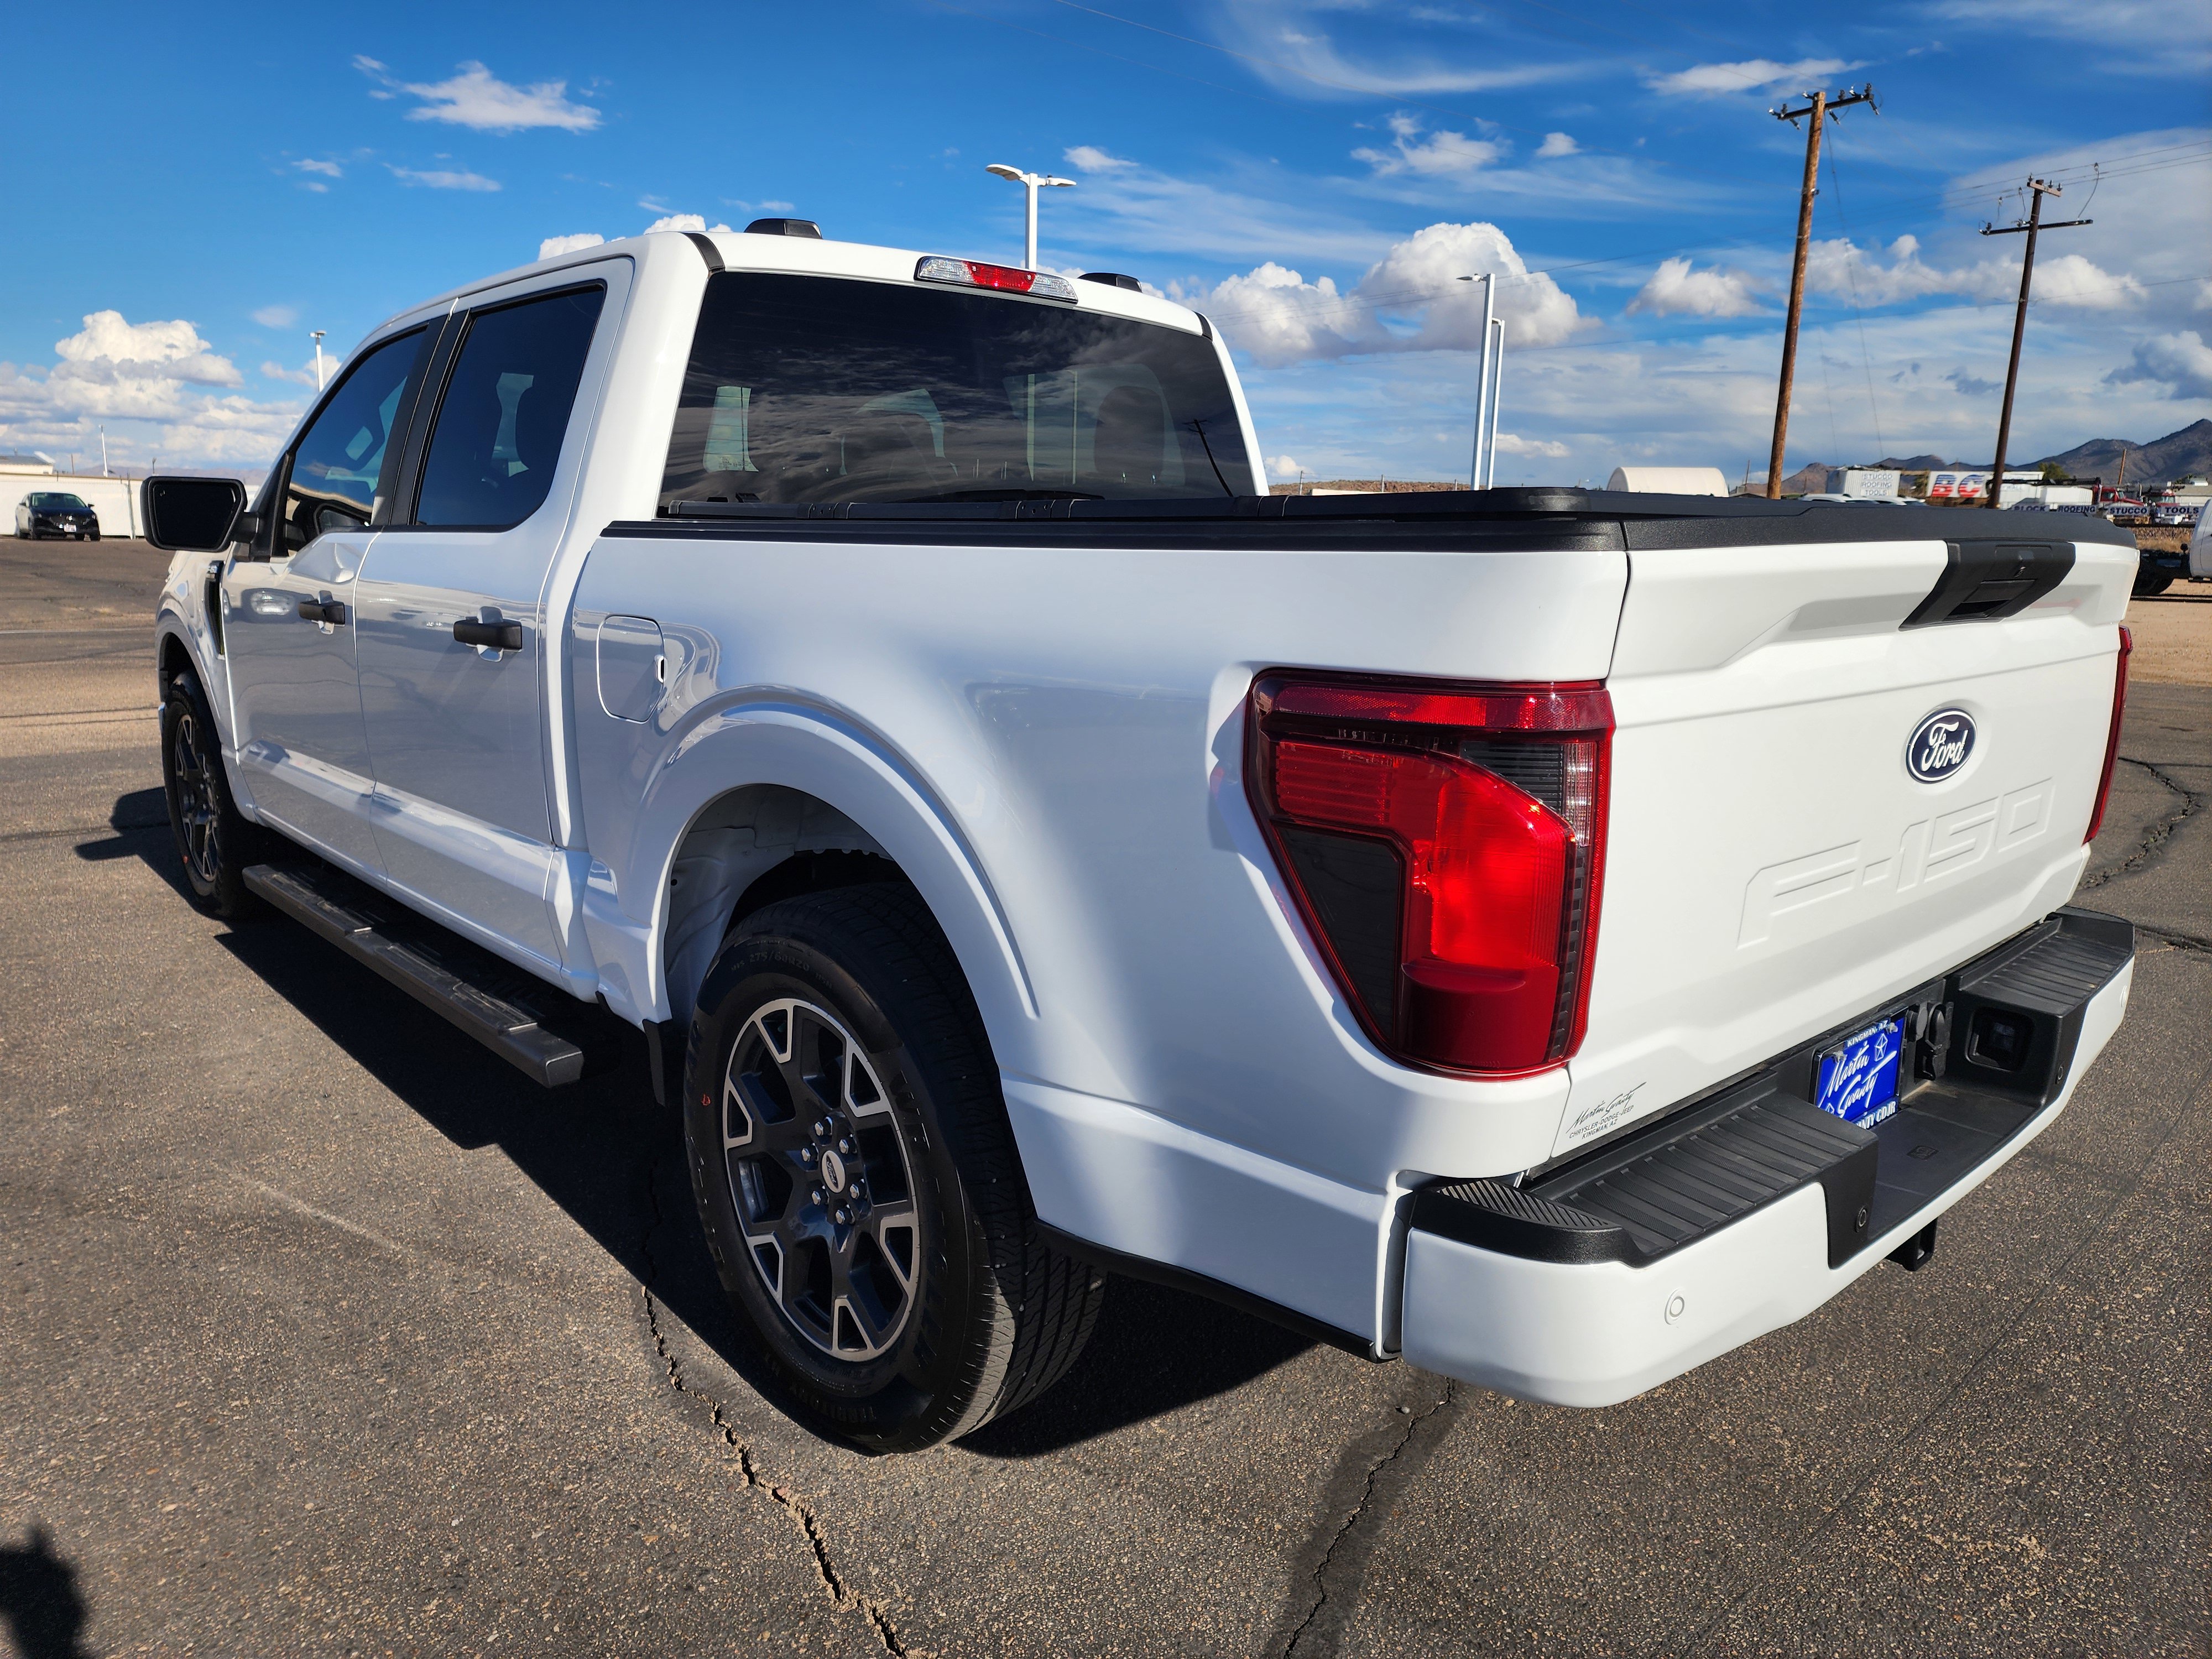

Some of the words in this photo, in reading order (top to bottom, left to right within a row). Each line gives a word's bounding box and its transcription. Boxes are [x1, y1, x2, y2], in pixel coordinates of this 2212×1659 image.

[1921, 721, 1969, 771] Ford
[1736, 776, 2056, 950] F-150
[1879, 1020, 1888, 1031] AZ
[1818, 1040, 1869, 1108] Martin
[1837, 1051, 1897, 1118] Swanty
[1566, 1100, 1605, 1133] Martin
[1610, 1119, 1618, 1128] AZ
